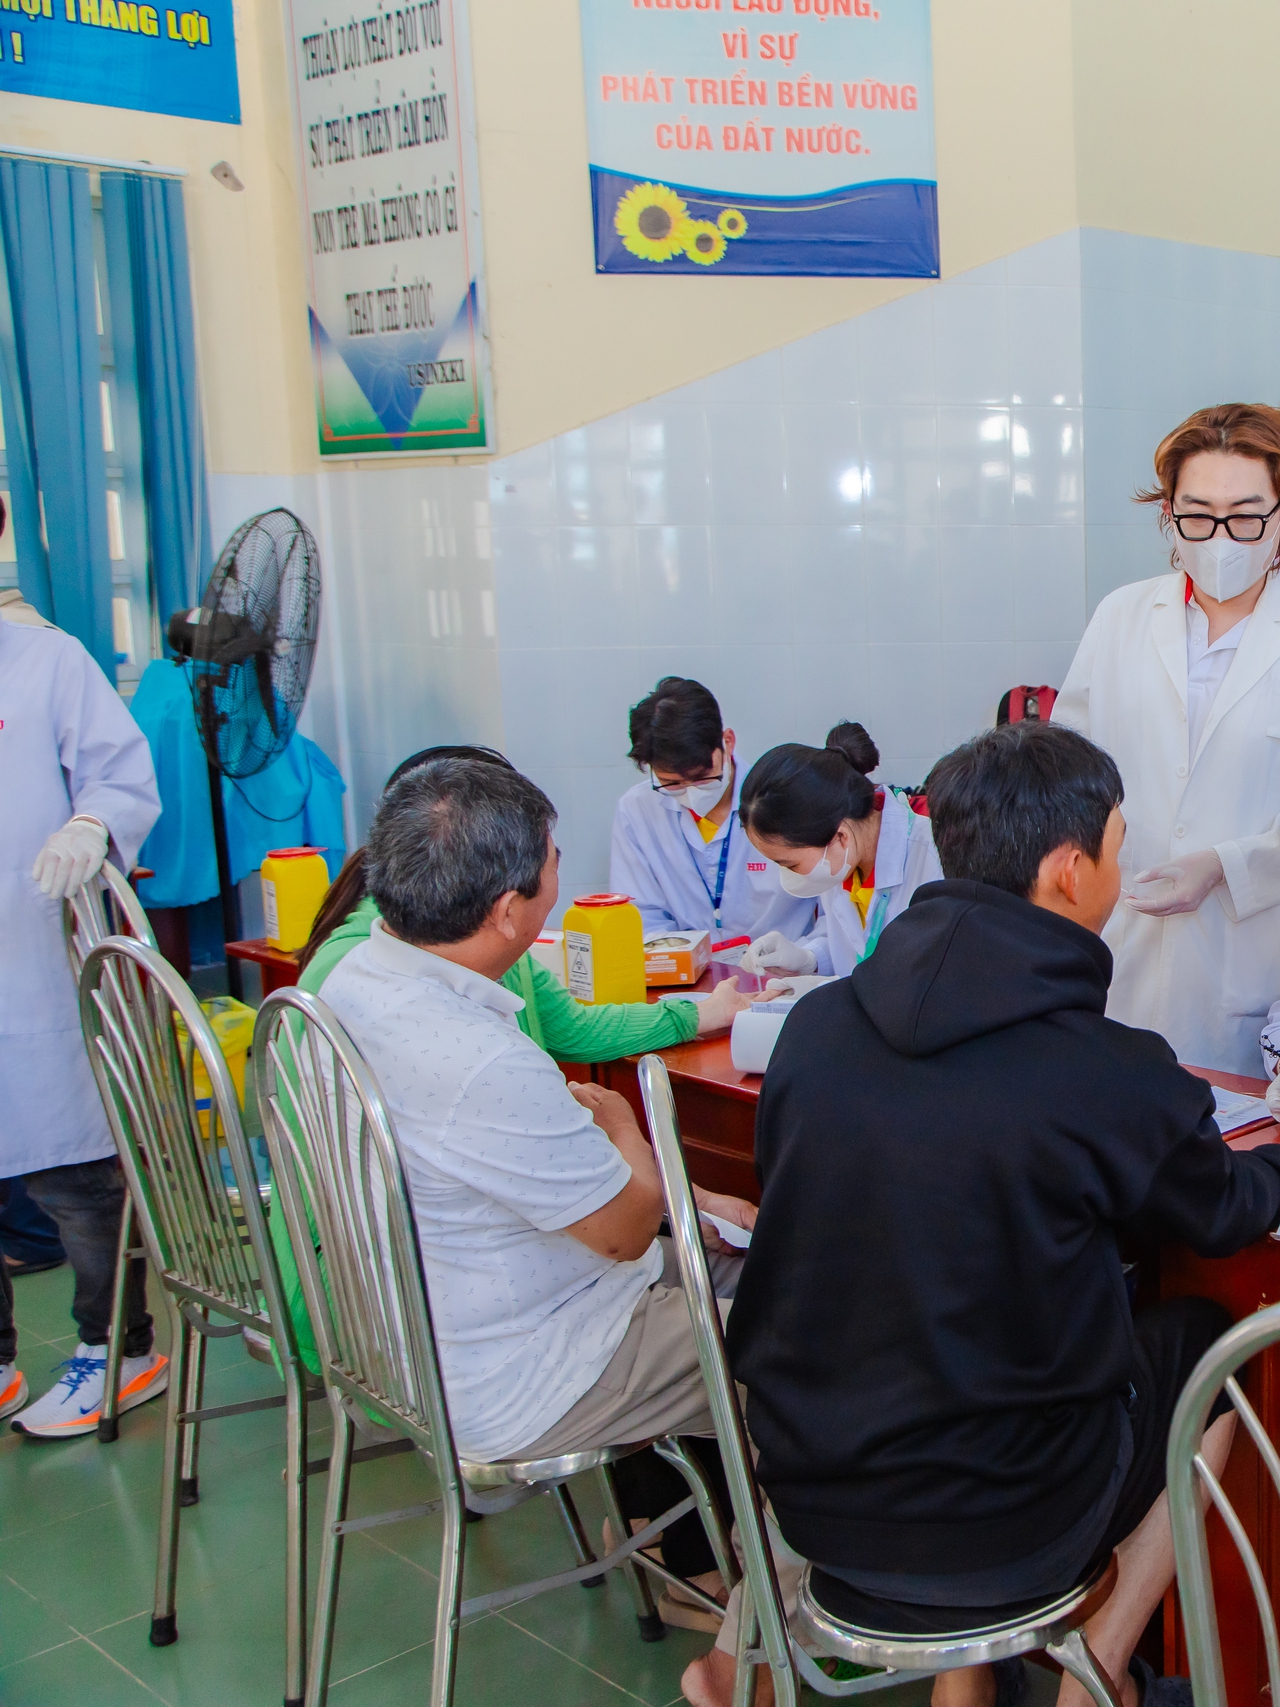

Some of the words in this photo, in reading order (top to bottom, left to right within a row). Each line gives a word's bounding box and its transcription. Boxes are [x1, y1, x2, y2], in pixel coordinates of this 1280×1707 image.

[166, 9, 211, 48] LỢI
[303, 18, 340, 87] THUẬN
[341, 15, 361, 82] LỢI
[362, 0, 395, 64] NHẤT
[721, 27, 748, 59] VÌ
[759, 32, 799, 67] SỰ
[601, 71, 676, 103] PHÁT
[685, 69, 767, 106] TRIỂN
[778, 73, 833, 109] BỀN
[843, 80, 918, 111] VỮNG
[309, 115, 325, 178] SỰ
[325, 103, 356, 165] PHÁT
[357, 79, 393, 158] TRIỂN
[394, 90, 422, 150] TÂM
[422, 67, 449, 144] HỒN
[656, 115, 714, 151] CỦA
[722, 117, 776, 153] ĐẤT
[785, 124, 871, 155] NƯỚC.
[313, 210, 336, 254] NON
[337, 187, 360, 250] TRẺ
[360, 187, 380, 247] MÀ
[381, 183, 423, 243] KHÔNG
[425, 174, 441, 236] CÓ
[444, 171, 458, 233] GÌ
[345, 291, 375, 336] THAY
[376, 264, 401, 332] THẾ
[402, 275, 435, 343] ĐƯỢC
[407, 359, 467, 387] USINXKI
[746, 862, 767, 871] HIU
